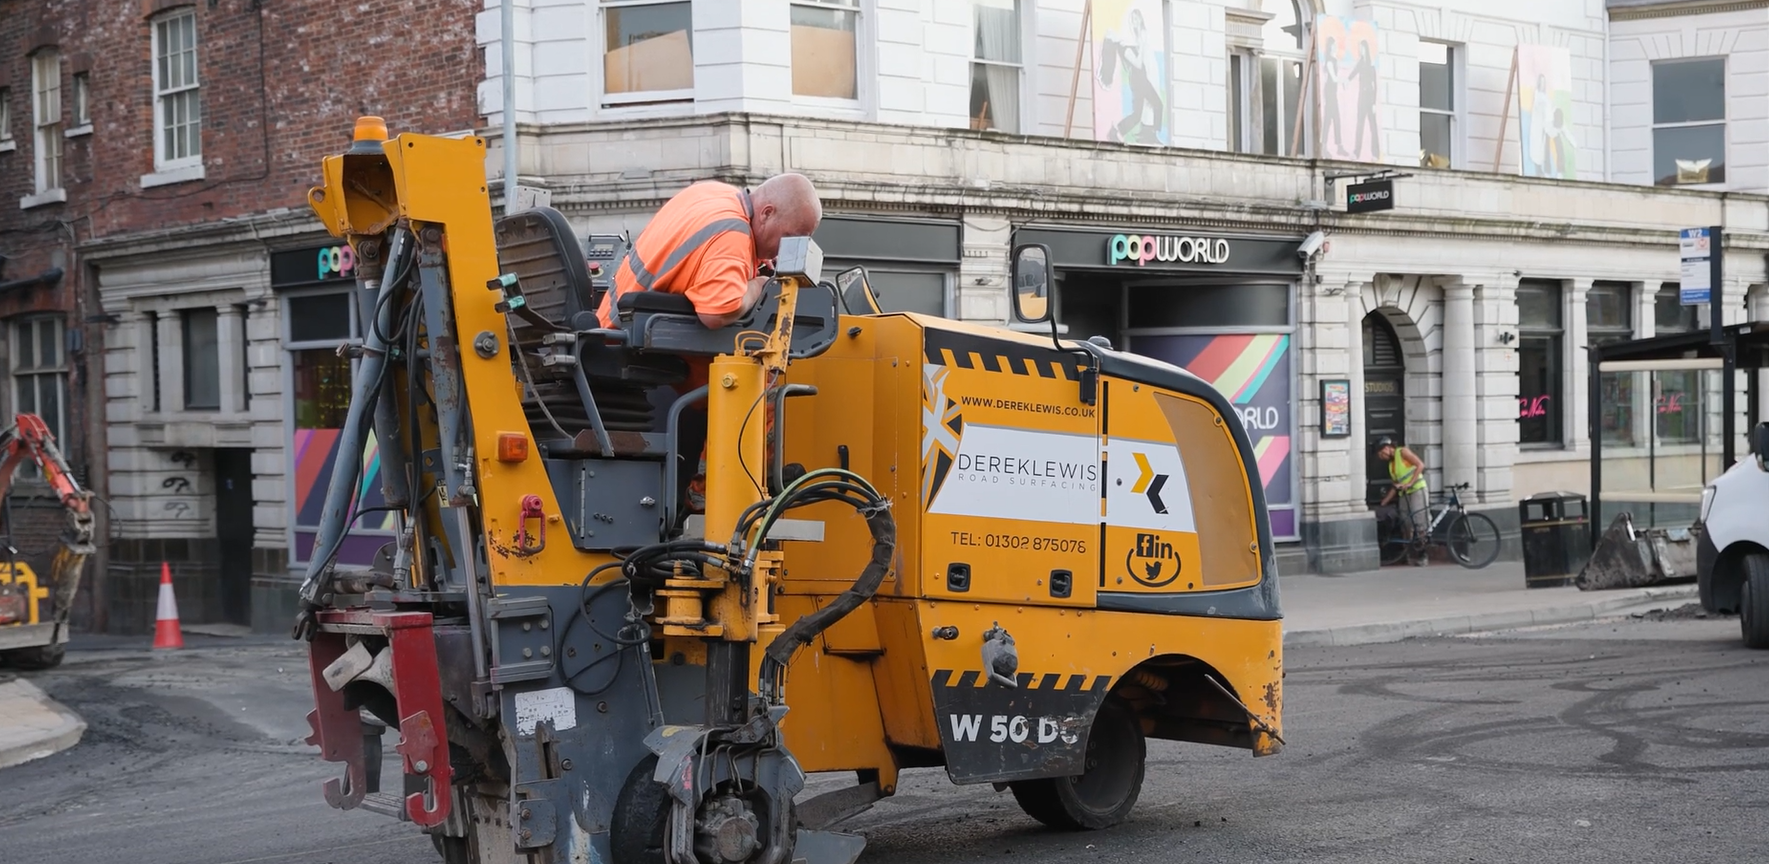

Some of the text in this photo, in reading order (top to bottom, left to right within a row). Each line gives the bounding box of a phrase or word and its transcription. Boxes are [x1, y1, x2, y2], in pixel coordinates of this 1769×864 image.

[317, 244, 353, 280] pop
[1109, 233, 1230, 266] popWORLD
[960, 396, 1096, 418] WWW.DEREKLEWIS.CO.UK
[958, 453, 1097, 481] DEREKLEWIS
[958, 473, 1096, 492] ROAD SURFACING
[951, 531, 981, 546] TEL:
[985, 533, 1029, 550] 01302
[950, 714, 983, 742] W
[989, 715, 1030, 743] 50
